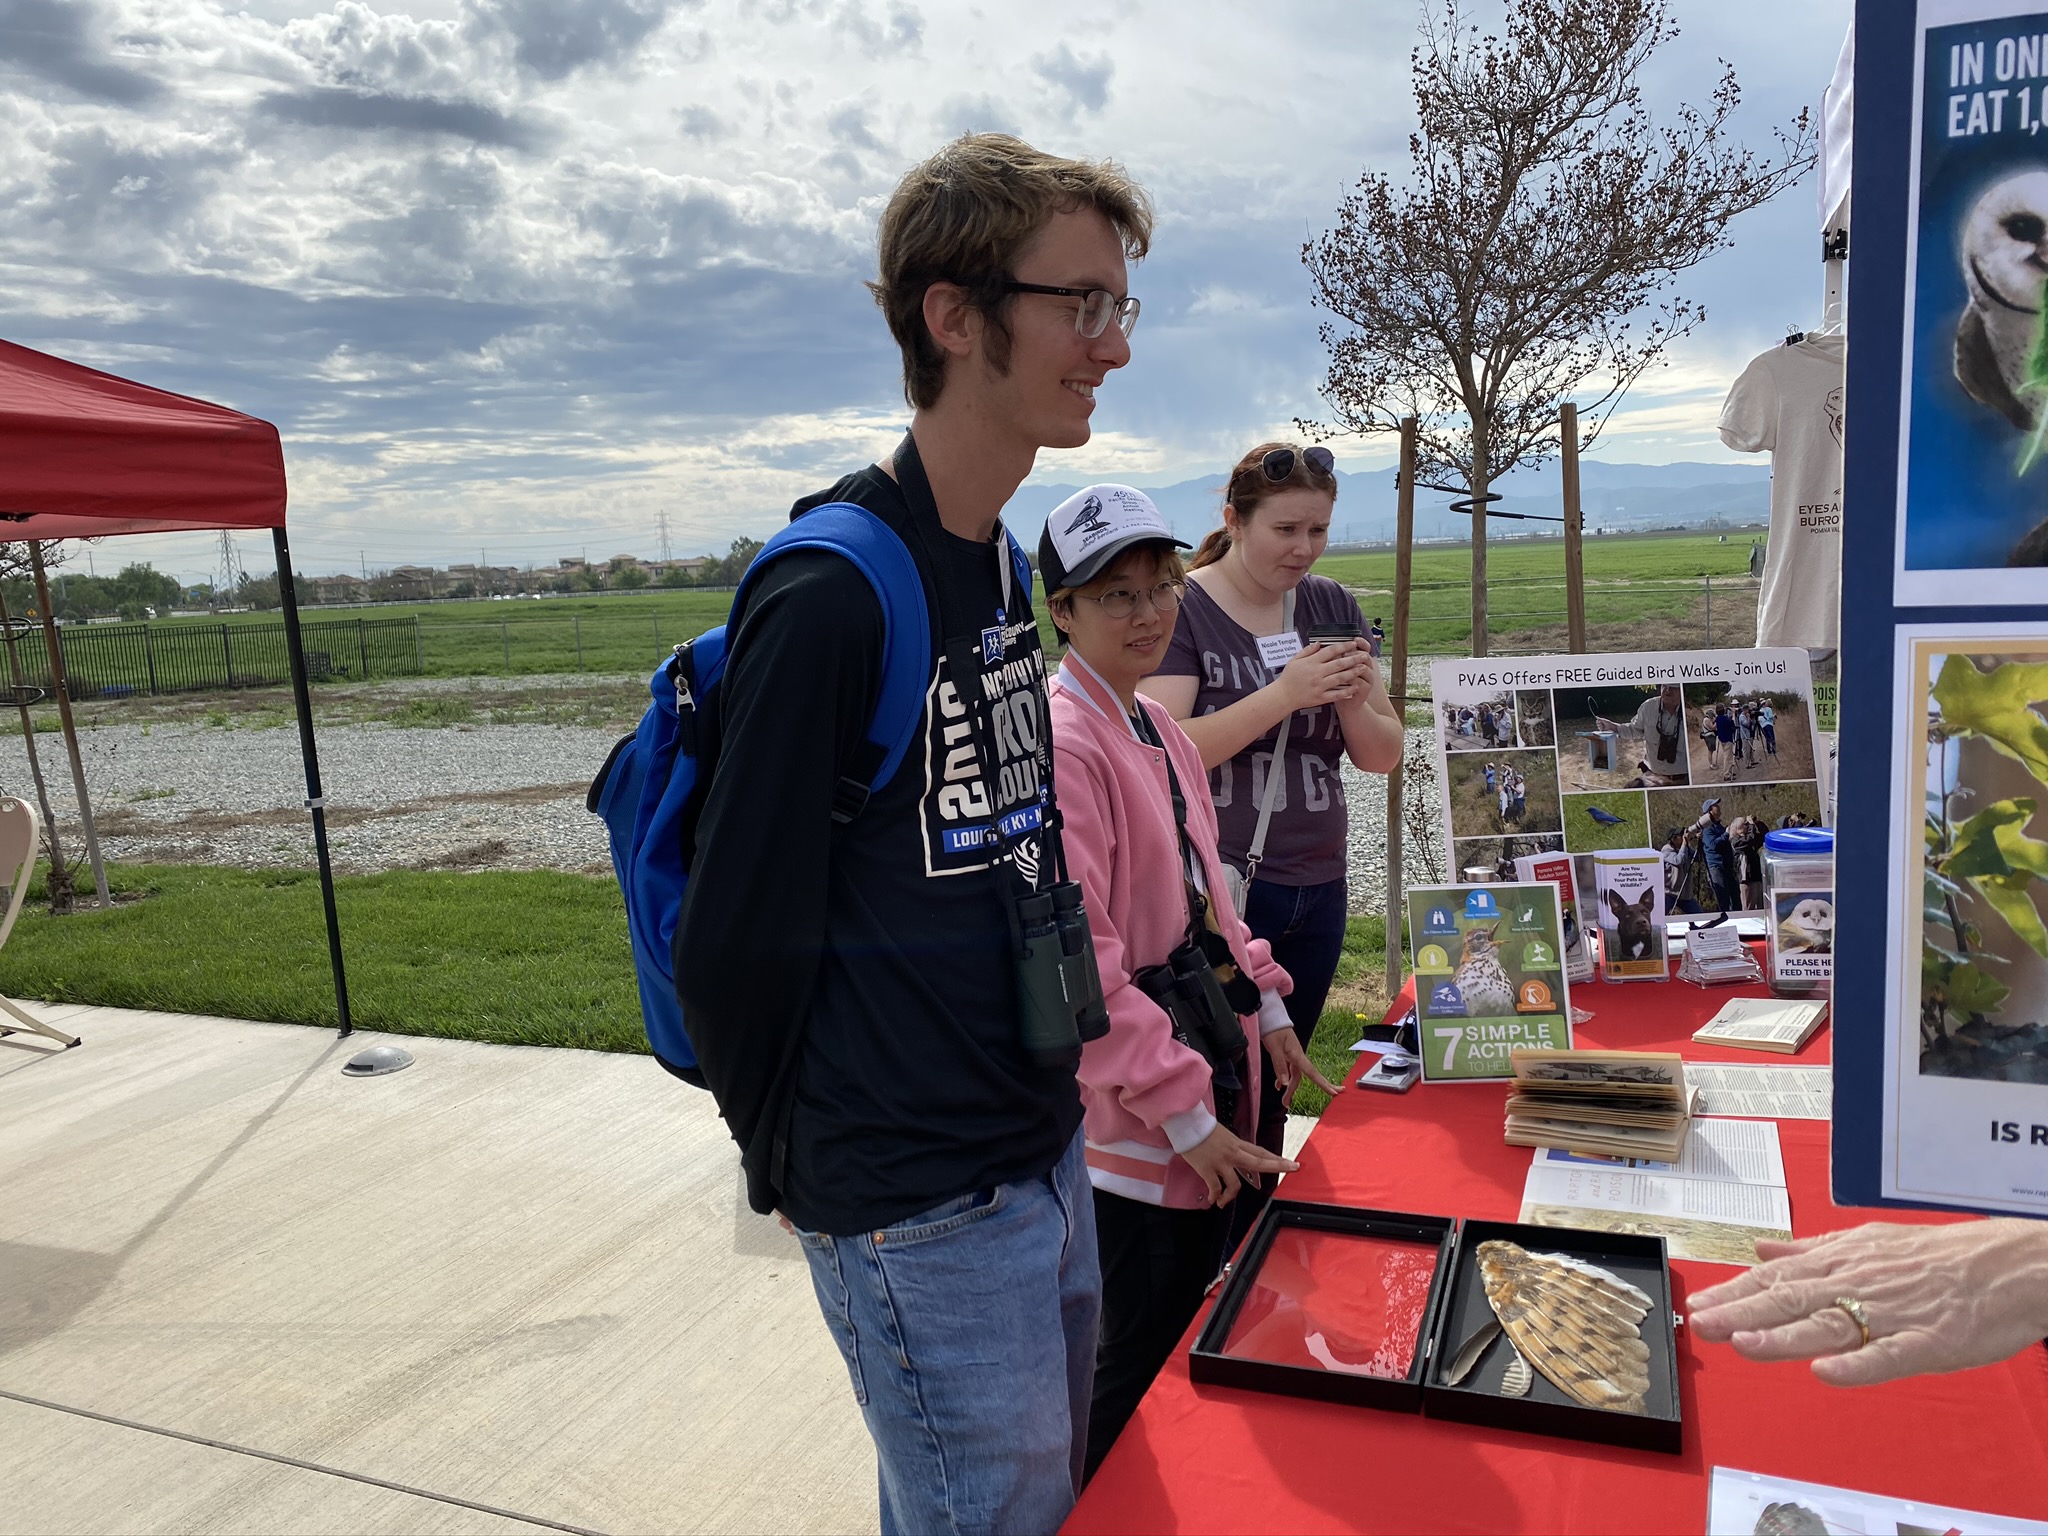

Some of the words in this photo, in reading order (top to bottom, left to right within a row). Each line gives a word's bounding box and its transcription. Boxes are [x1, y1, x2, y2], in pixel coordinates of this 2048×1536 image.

[1950, 41, 1985, 88] IN
[1948, 89, 2009, 138] EAT
[1799, 503, 1830, 514] EYES
[1458, 673, 1498, 687] PVAS
[1502, 671, 1551, 685] Offers
[1556, 668, 1592, 683] FREE
[1596, 666, 1643, 681] Guided
[1647, 665, 1675, 679] Bird
[1679, 663, 1720, 677] Walks
[1734, 662, 1762, 676] Join
[1766, 660, 1787, 674] Us!
[1011, 813, 1027, 830] KY
[1785, 959, 1819, 967] PLEASE
[1466, 1023, 1551, 1041] SIMPLE
[1434, 1027, 1463, 1071] 7
[1468, 1062, 1484, 1072] TO
[1991, 1121, 2021, 1143] IS
